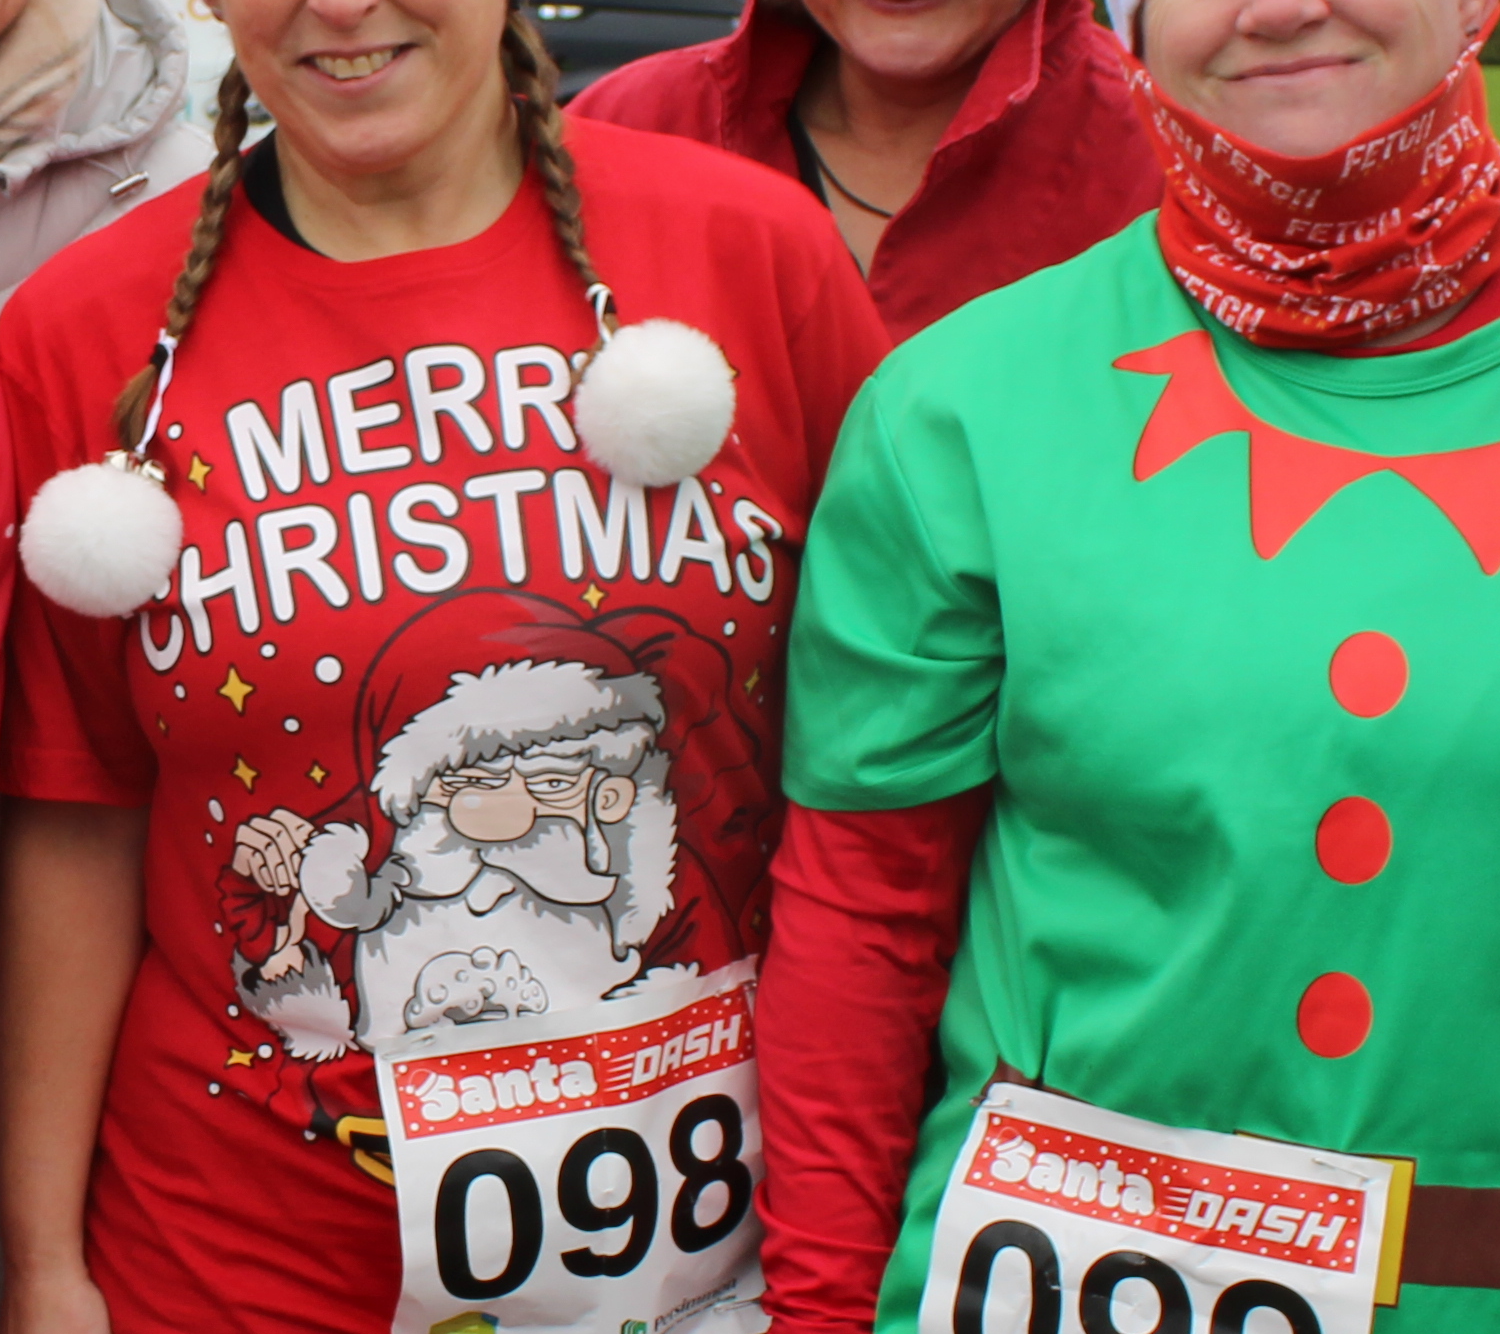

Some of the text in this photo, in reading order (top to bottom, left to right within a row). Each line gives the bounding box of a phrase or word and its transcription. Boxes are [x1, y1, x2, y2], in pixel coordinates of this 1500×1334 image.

[1211, 132, 1322, 211] FETCH
[1286, 207, 1402, 245] FETCH
[226, 344, 588, 501] MERR
[420, 1014, 742, 1123] Santa DASH
[434, 1093, 753, 1301] 098
[989, 1134, 1348, 1253] Santa DASH
